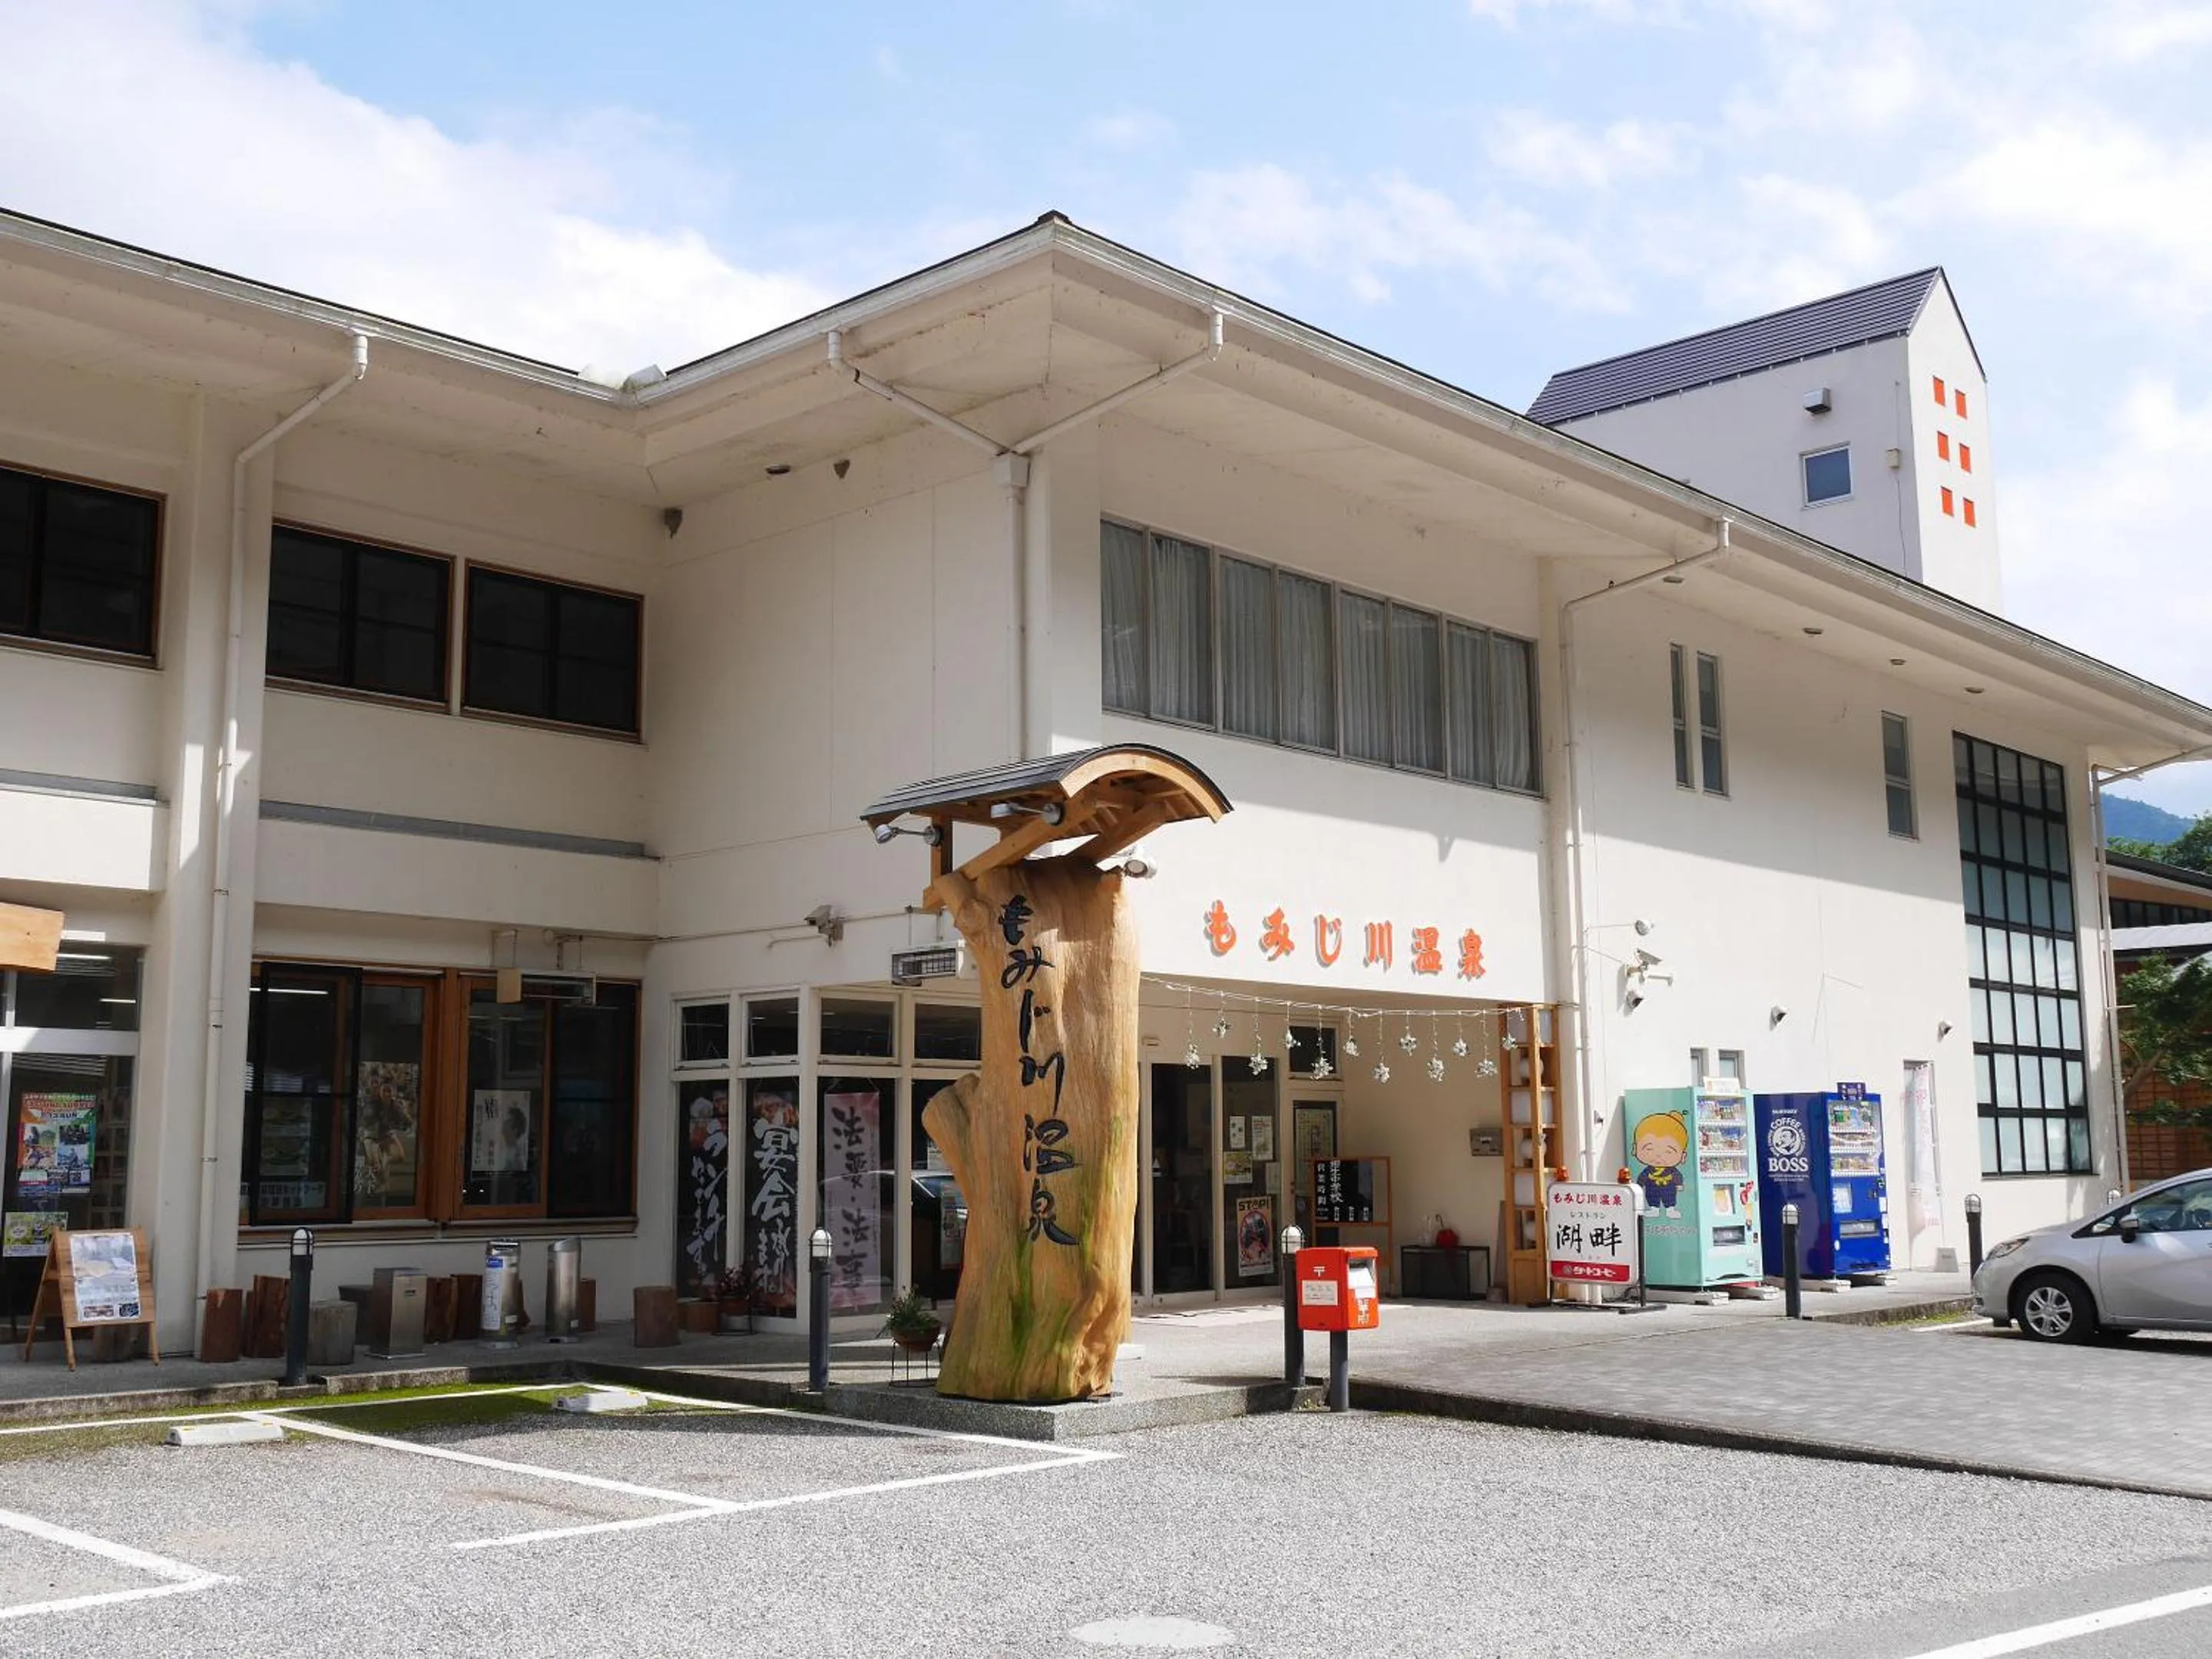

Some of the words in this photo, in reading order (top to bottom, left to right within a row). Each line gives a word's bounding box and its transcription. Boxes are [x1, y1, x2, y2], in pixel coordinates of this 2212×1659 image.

[1204, 899, 1485, 980] もみじ川温泉
[998, 894, 1080, 1246] もみじ川温泉
[1770, 1117, 1801, 1129] COFFEE
[752, 1110, 799, 1223] 宴会
[1768, 1157, 1808, 1172] BOSS
[1553, 1192, 1622, 1206] もみじ川温泉
[1556, 1222, 1622, 1257] 湖畔
